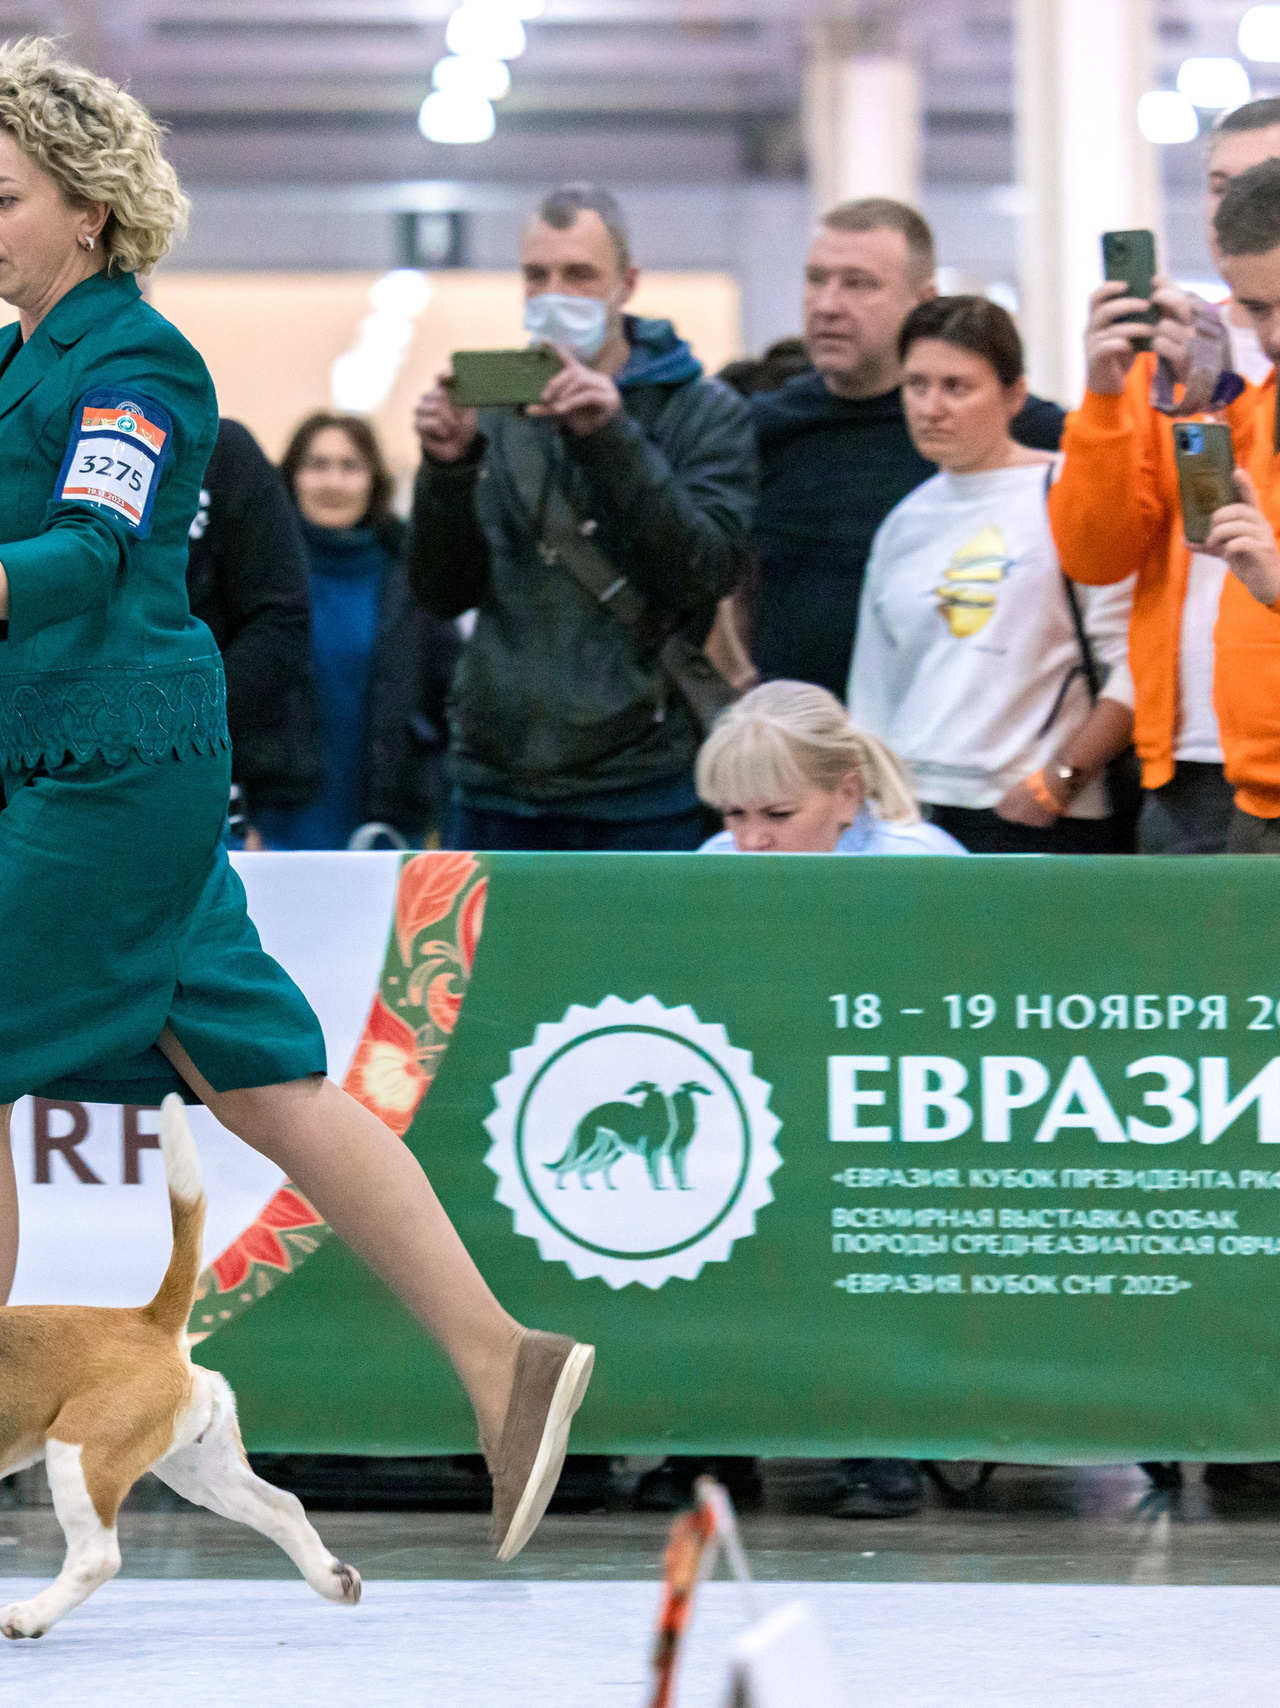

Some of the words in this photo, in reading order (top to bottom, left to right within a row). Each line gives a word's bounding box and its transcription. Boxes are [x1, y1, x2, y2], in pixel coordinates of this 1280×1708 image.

[79, 455, 144, 492] 3275
[87, 487, 126, 507] 19.11.2023
[829, 994, 882, 1030] 18
[943, 994, 996, 1030] 19
[1016, 994, 1228, 1031] НОЯБРЯ
[1246, 994, 1280, 1031] 2
[827, 1056, 1280, 1145] ЕВРАЗИ
[969, 1168, 1057, 1188] КУБОК
[1060, 1169, 1236, 1192] ПРЕЗИДЕНТА
[832, 1208, 995, 1228] ВСЕМИРНАЯ
[998, 1209, 1144, 1229] ВЫСТАВКА
[1146, 1209, 1240, 1230] СОБАК
[832, 1233, 949, 1256] ПОРОДЫ
[952, 1234, 1215, 1257] СРЕДНЕАЗИАТСКАЯ
[970, 1274, 1059, 1295] КУБОК
[1062, 1274, 1118, 1295] СНГ
